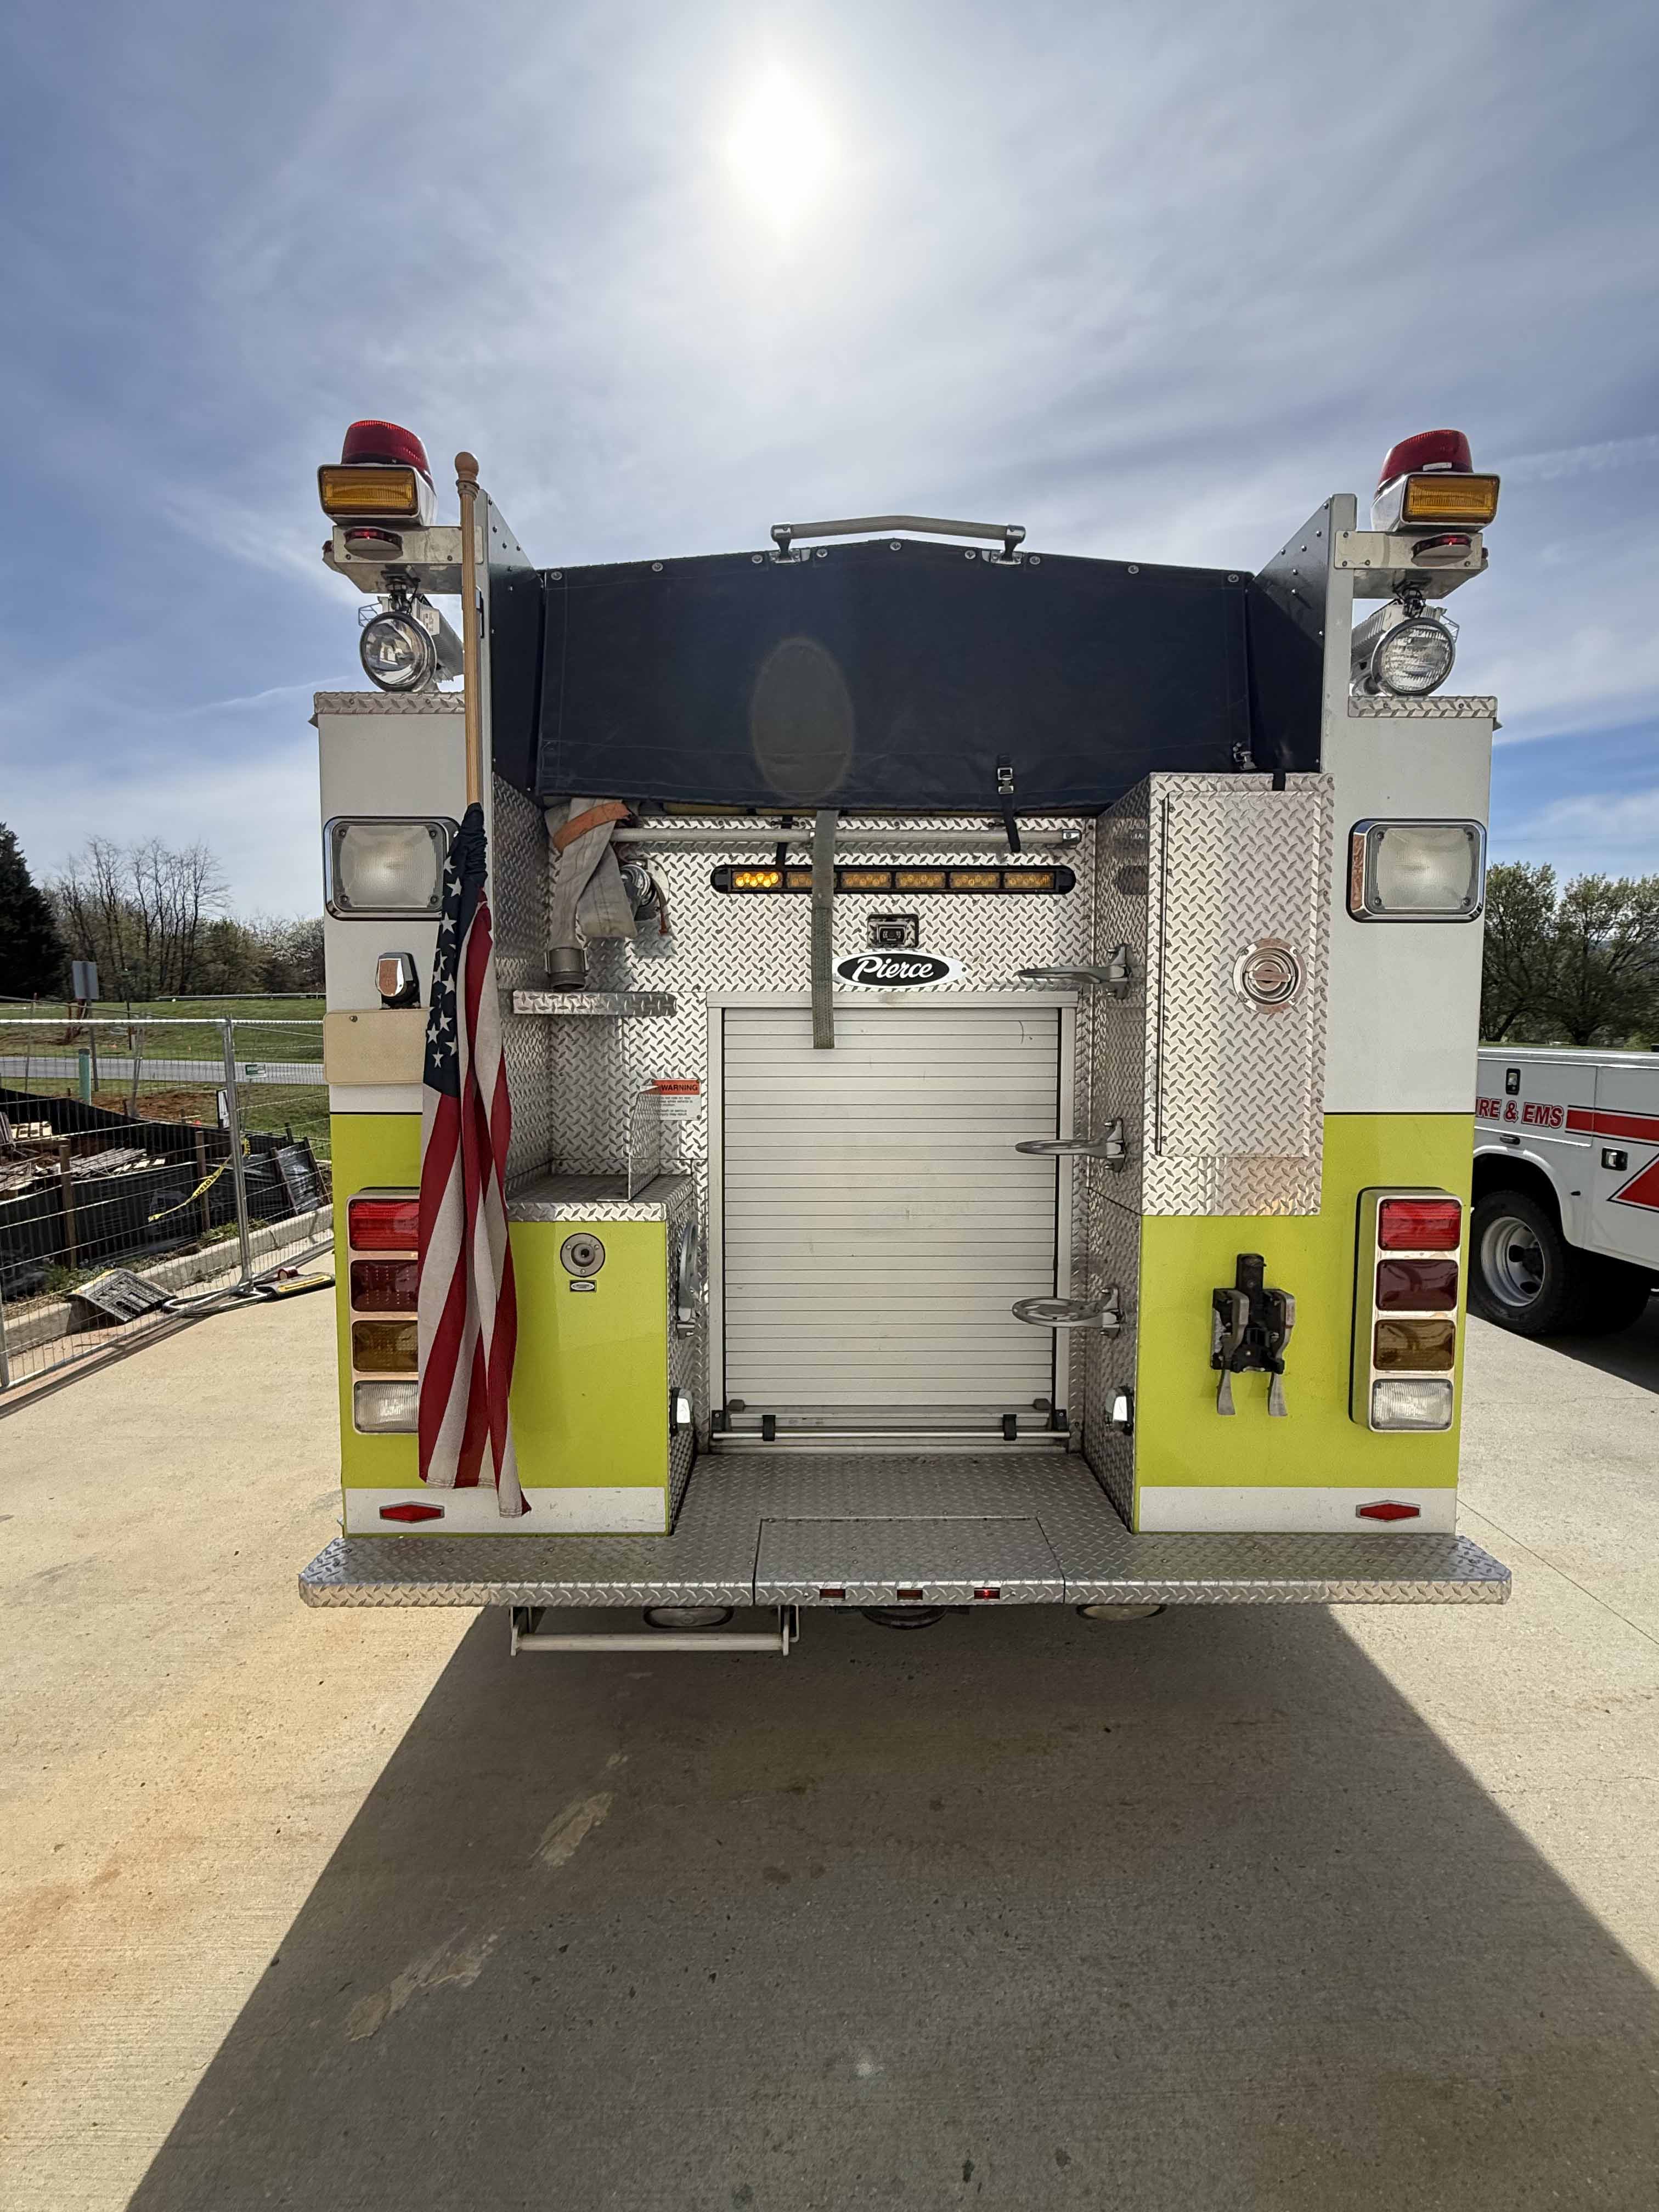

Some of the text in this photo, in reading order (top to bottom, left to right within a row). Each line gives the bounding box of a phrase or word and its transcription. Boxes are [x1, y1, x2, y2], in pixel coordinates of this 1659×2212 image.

[851, 956, 934, 981] Pierce
[1475, 1097, 1564, 1128] IRE & EMS
